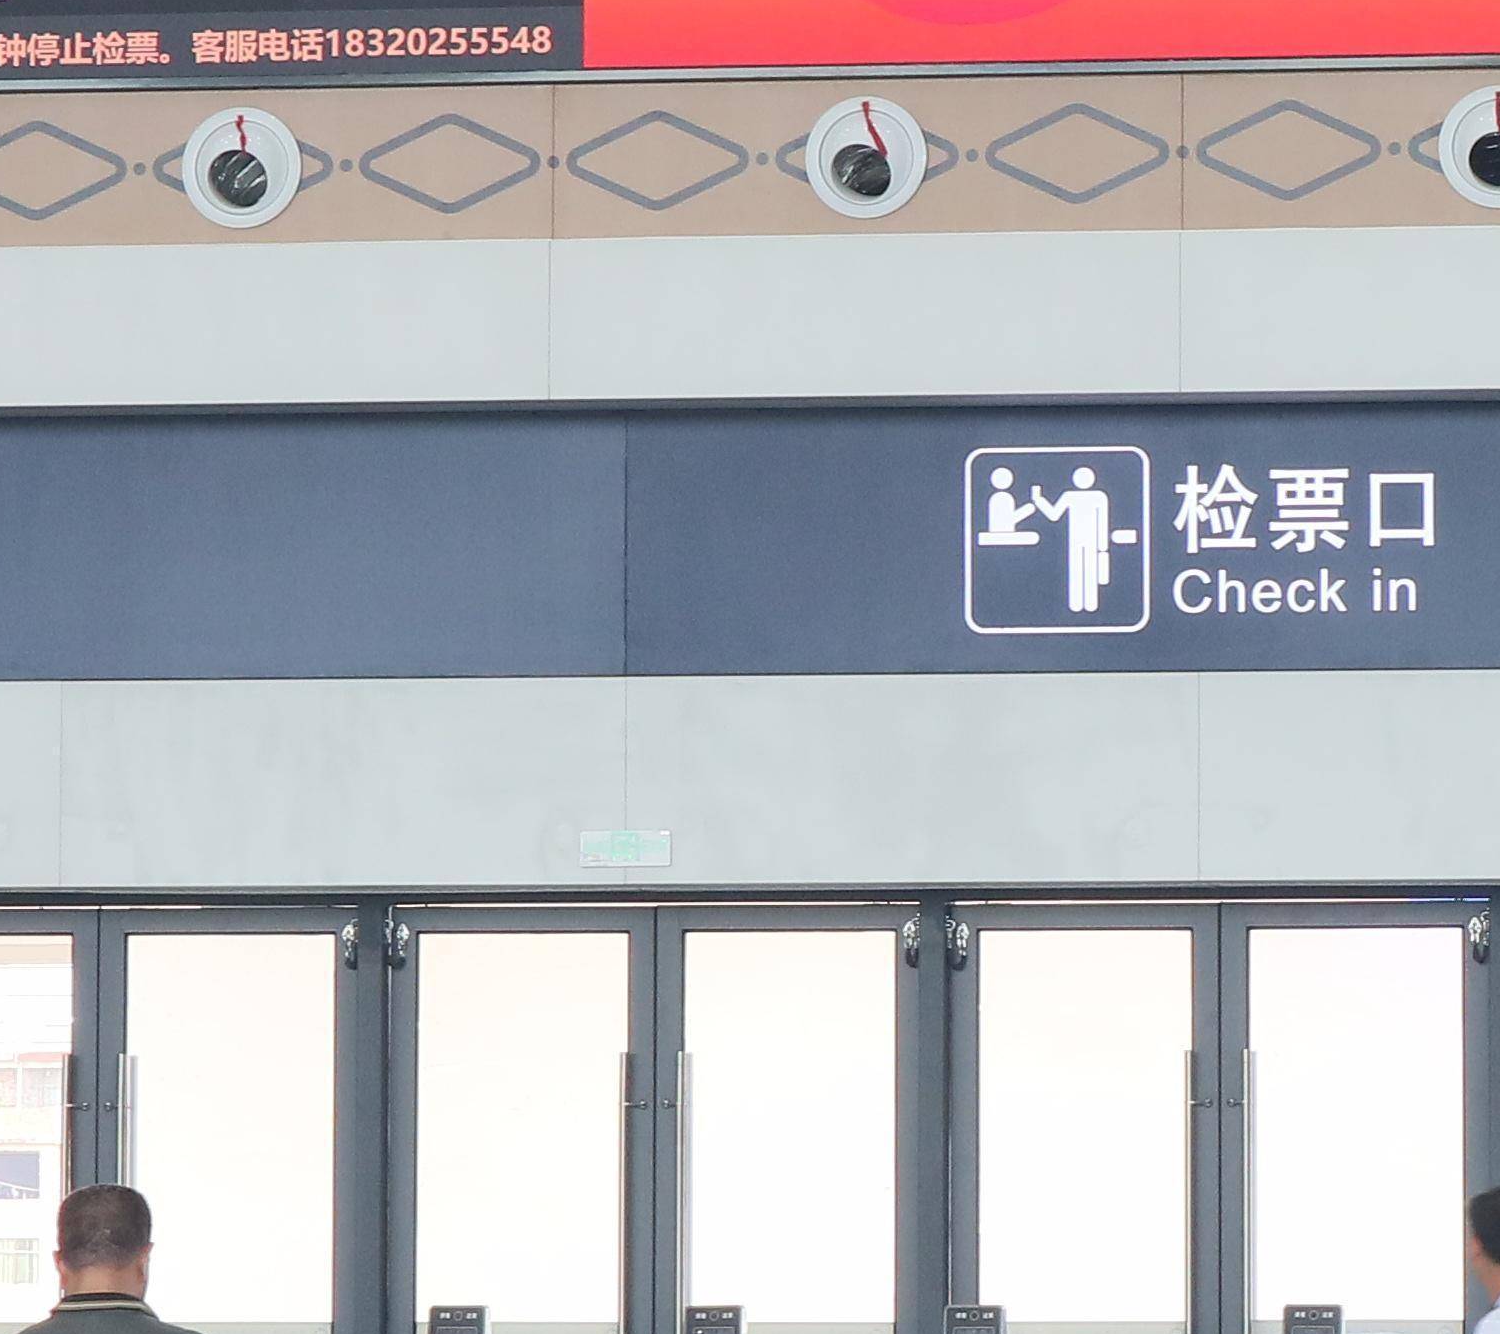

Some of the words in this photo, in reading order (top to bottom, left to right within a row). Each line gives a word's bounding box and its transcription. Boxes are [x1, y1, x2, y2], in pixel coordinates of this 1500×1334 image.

[1174, 465, 1434, 553] 检票口
[1174, 569, 1346, 613] Check
[1374, 569, 1416, 611] in
